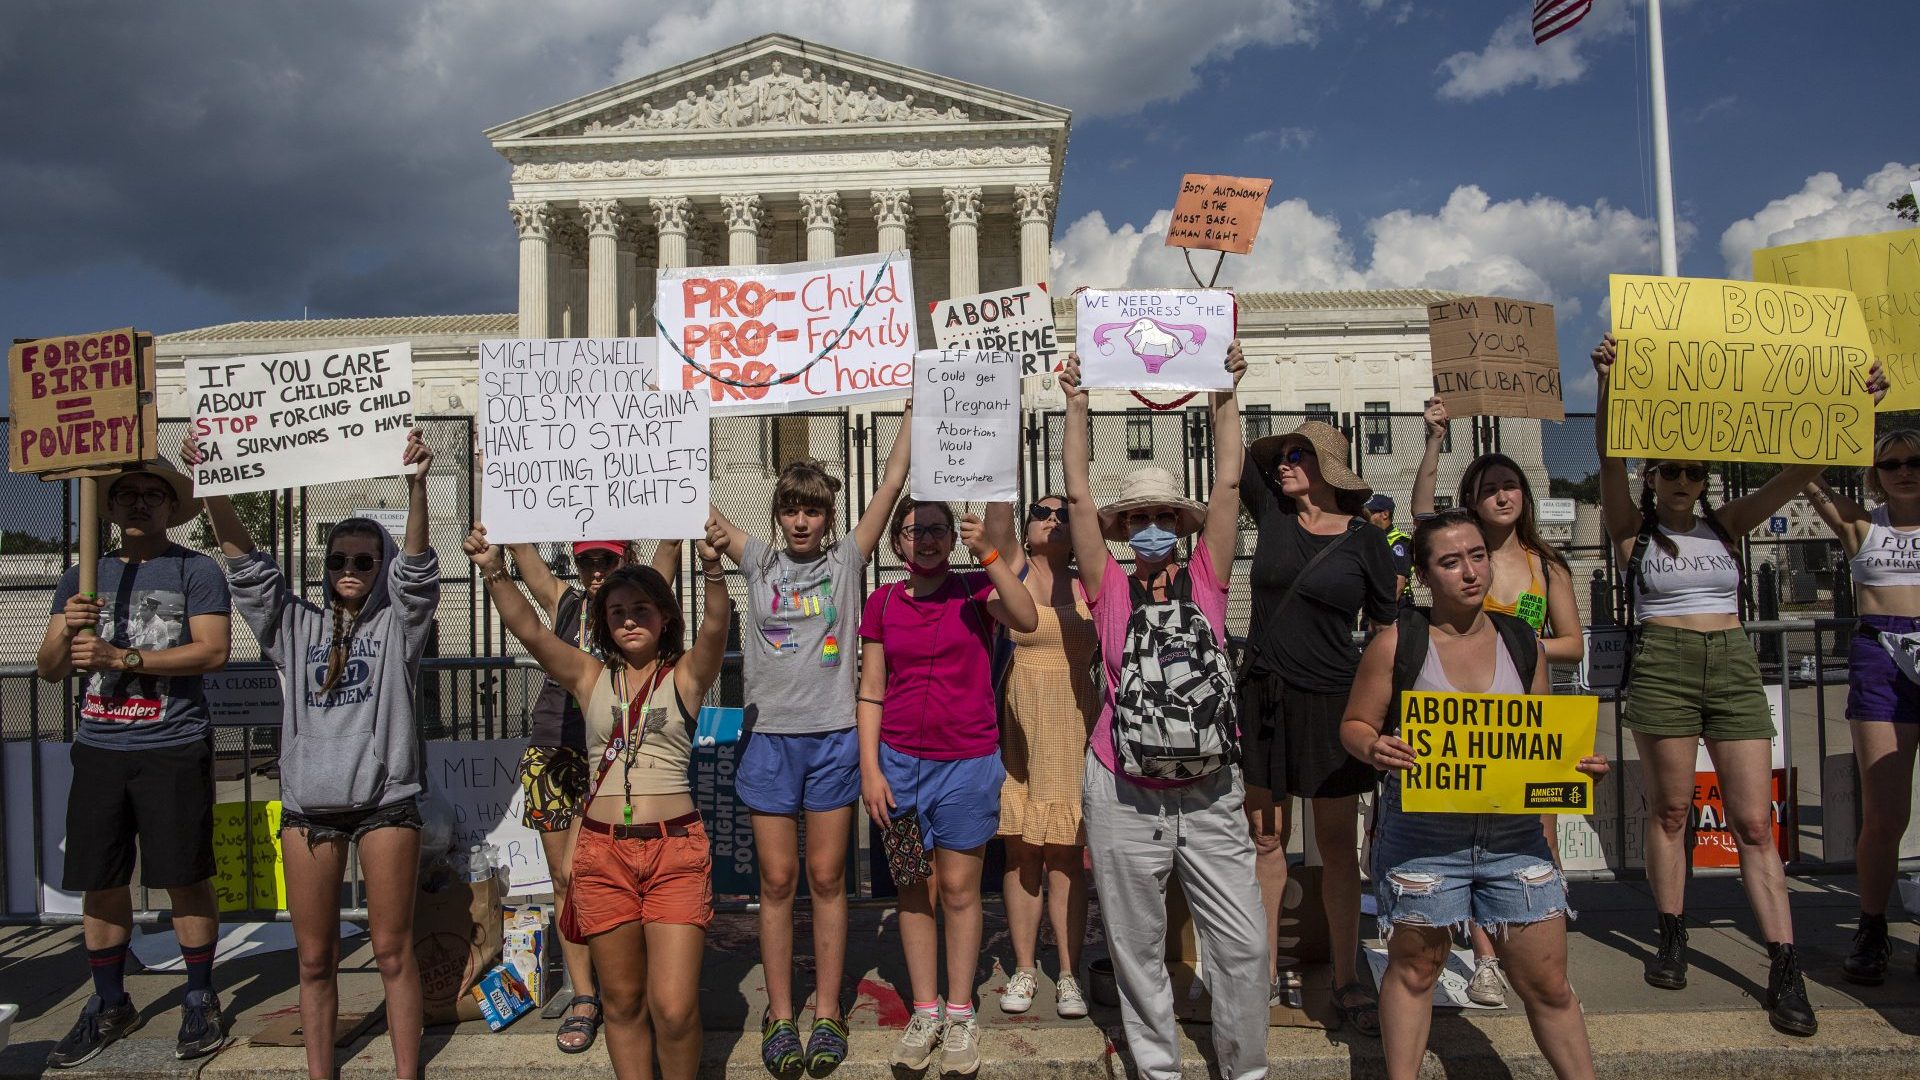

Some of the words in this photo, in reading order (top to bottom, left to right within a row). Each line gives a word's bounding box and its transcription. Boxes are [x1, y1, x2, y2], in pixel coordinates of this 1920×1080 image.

[1183, 182, 1207, 195] BODY
[1213, 186, 1264, 200] AUTONOMY
[1201, 200, 1208, 209] IS
[1211, 200, 1227, 211] THE
[1175, 213, 1201, 224] MOST
[1206, 215, 1238, 226] BASIC
[1170, 227, 1200, 239] HUMAN
[1204, 228, 1238, 243] RIGHT
[1886, 238, 1920, 287] M
[945, 292, 1031, 328] ABORT
[1084, 295, 1109, 309] WE
[1118, 295, 1162, 306] NEED
[1178, 295, 1198, 306] TO
[1121, 306, 1181, 317] ADDRESS
[1198, 306, 1225, 316] THE
[1430, 301, 1478, 321] I'M
[1494, 303, 1536, 327] NOT
[1619, 282, 1690, 330] MY
[1722, 285, 1847, 338] BODY
[982, 325, 1000, 336] the
[1468, 331, 1530, 357] YOUR
[22, 334, 131, 373] FORCED
[481, 340, 568, 369] MIGHT
[939, 350, 968, 363] IF
[975, 351, 1014, 364] MEN
[1614, 337, 1656, 390] IS
[1668, 340, 1754, 391] NOT
[1762, 343, 1870, 396] YOUR
[31, 358, 132, 400] BIRTH
[199, 363, 245, 389] IF
[261, 358, 311, 385] YOU
[323, 349, 390, 378] CARE
[485, 371, 528, 397] SET
[535, 368, 586, 395] YOUR
[927, 367, 965, 384] Could
[976, 372, 996, 386] get
[1437, 367, 1560, 397] INCUBATOR
[196, 390, 266, 414] ABOUT
[280, 375, 383, 402] CHILDREN
[488, 395, 557, 424] DOES
[564, 394, 601, 419] MY
[612, 390, 699, 419] VAGINA
[943, 387, 1011, 415] Pregnant
[196, 415, 258, 436] STOP
[270, 400, 351, 428] FORCING
[359, 390, 411, 413] CHILD
[20, 415, 138, 465] POVERTY
[198, 441, 223, 465] SA
[236, 428, 329, 457] SURVIVORS
[338, 423, 364, 438] TO
[375, 413, 413, 433] HAVE
[485, 424, 534, 458] HAVE
[541, 423, 576, 450] TO
[589, 420, 682, 449] START
[936, 420, 996, 438] Abortions
[1610, 398, 1863, 460] INCUBATOR
[939, 441, 972, 451] Would
[948, 455, 965, 465] be
[198, 462, 266, 485] BABIES
[487, 458, 593, 488] SHOOTING
[604, 447, 708, 480] BULLETS
[934, 471, 993, 486] Everywhere
[504, 487, 537, 509] TO
[547, 485, 600, 508] GET
[608, 478, 697, 509] RIGHTS
[574, 507, 595, 537] ?
[1881, 536, 1920, 550] FUC
[1889, 549, 1919, 558] THE
[1866, 556, 1920, 569] PATRIAR
[226, 677, 278, 689] CLOSED
[107, 702, 156, 716] Sanders
[1405, 696, 1543, 727] ABORTION
[698, 735, 716, 754] IS
[1407, 729, 1432, 757] IS
[1442, 731, 1457, 758] A
[1468, 731, 1563, 761] HUMAN
[444, 757, 522, 789] MEN
[716, 745, 735, 787] FOR
[1406, 762, 1487, 791] RIGHT
[698, 762, 714, 814] TIME
[1531, 788, 1563, 797] AMNESTY
[477, 801, 521, 823] HAV
[715, 792, 734, 857] RIGHT
